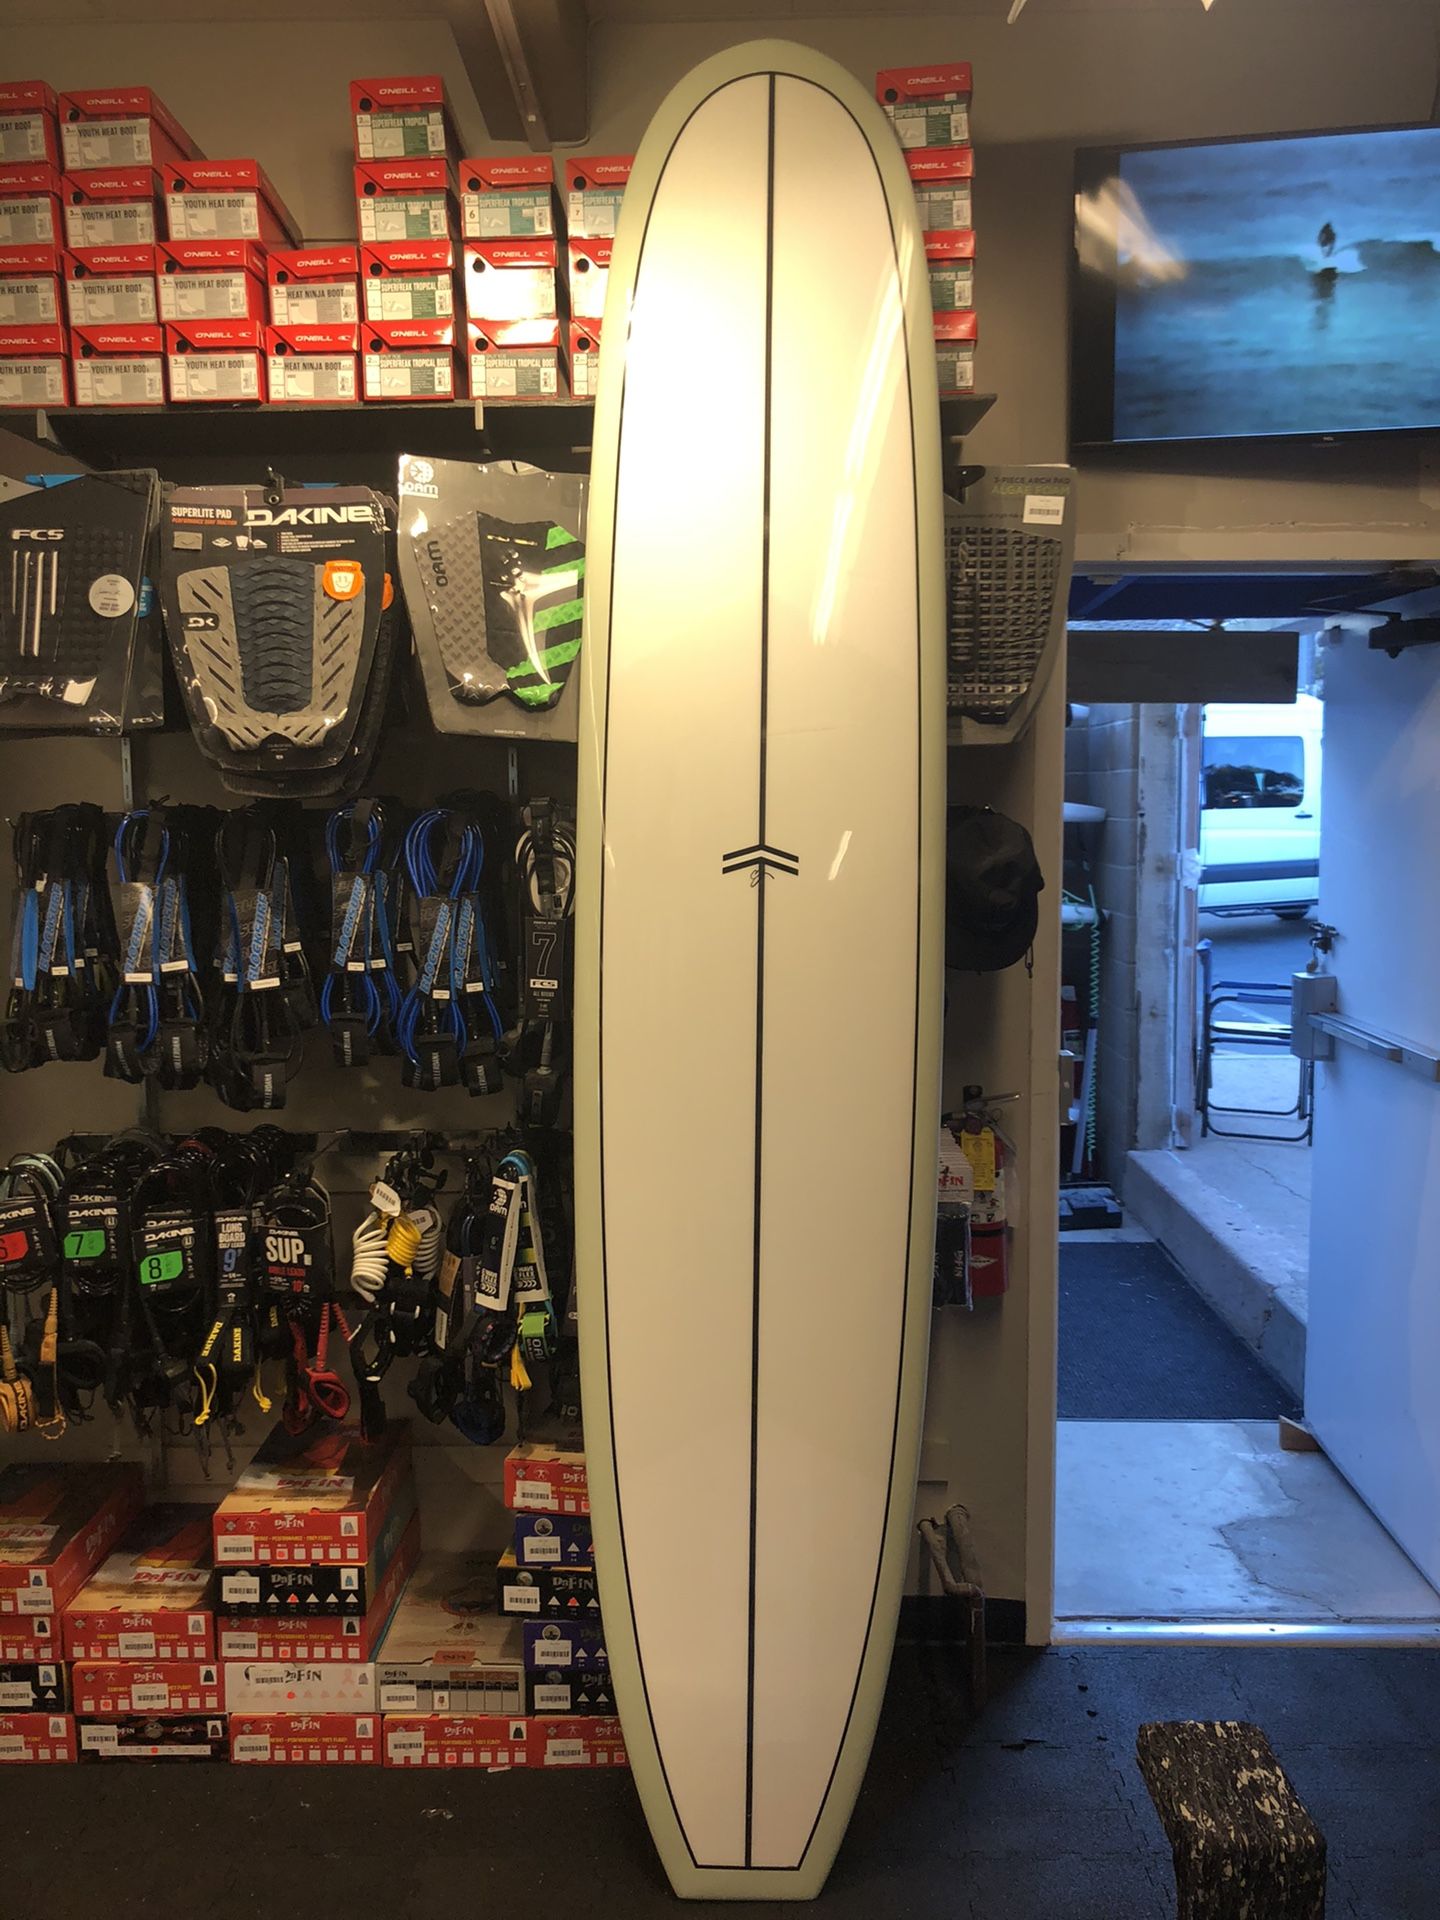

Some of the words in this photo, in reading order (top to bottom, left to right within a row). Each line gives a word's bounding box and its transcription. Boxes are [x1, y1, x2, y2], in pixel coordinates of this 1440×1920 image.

[78, 128, 100, 138] YOUTH
[101, 127, 118, 136] HEAT
[120, 126, 137, 135] BOOT
[183, 199, 207, 209] YOUTH
[208, 199, 226, 208] HEAT
[227, 198, 245, 208] BOOT
[4, 205, 19, 215] HEAT
[22, 204, 39, 214] BOOT
[469, 210, 476, 219] 6
[82, 211, 104, 221] YOUTH
[105, 210, 121, 219] HEAT
[5, 285, 23, 294] HEAT
[84, 285, 106, 295] YOUTH
[107, 284, 123, 294] HEAT
[125, 284, 142, 293] BOOT
[174, 280, 197, 290] YOUTH
[198, 279, 215, 289] HEAT
[217, 278, 234, 288] BOOT
[287, 290, 303, 299] HEAT
[304, 289, 326, 299] NINJA
[327, 288, 344, 298] BOOT
[91, 366, 113, 375] YOUTH
[115, 365, 131, 374] HEAT
[186, 360, 207, 370] YOUTH
[208, 359, 226, 369] HEAT
[228, 359, 245, 368] BOOT
[284, 362, 301, 371] HEAT
[302, 361, 323, 371] NINJA
[324, 361, 341, 370] BOOT
[15, 366, 31, 375] HEAT
[171, 506, 215, 518] SUPERLITE
[215, 508, 232, 519] PAD
[242, 504, 376, 527] DAKINE
[11, 528, 65, 541] FCS
[335, 875, 364, 968] BLOCKSURF
[247, 891, 269, 983] BLOCKSURF
[419, 902, 450, 995] BLOCKSURF
[532, 931, 557, 977] 7
[67, 1207, 119, 1218] DAKINE
[221, 1222, 243, 1233] LONG
[144, 1226, 196, 1243] DAKINE
[218, 1232, 246, 1243] BOARD
[70, 1233, 84, 1256] 7
[148, 1256, 162, 1280] 8
[200, 1321, 224, 1357] DAKINE
[232, 1327, 242, 1362] DAKINE
